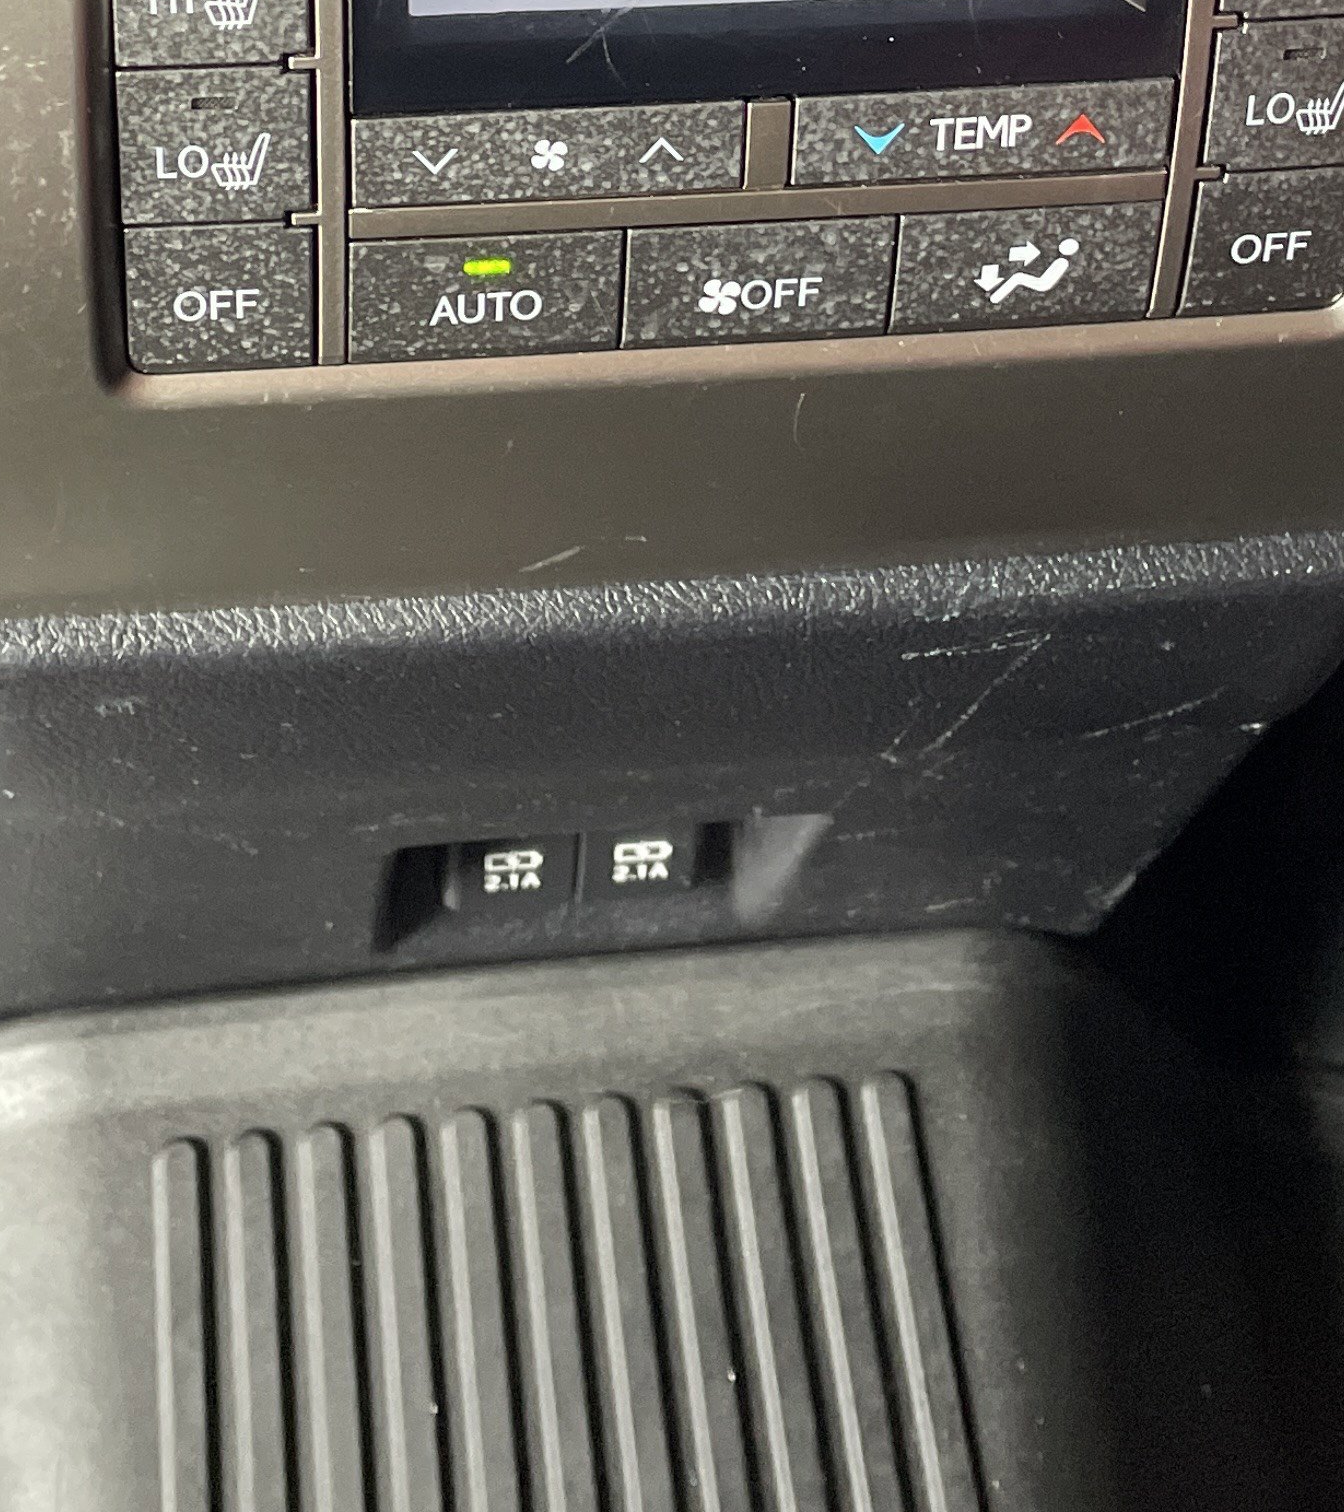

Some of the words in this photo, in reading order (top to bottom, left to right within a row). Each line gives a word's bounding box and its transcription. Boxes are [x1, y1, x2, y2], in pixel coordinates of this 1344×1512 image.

[1244, 91, 1295, 127] LO
[929, 114, 1033, 152] TEMP
[155, 144, 209, 180] LO
[1229, 230, 1312, 265] OFF
[172, 288, 260, 322] OFF
[428, 289, 543, 328] AUTO
[740, 276, 824, 310] OFF
